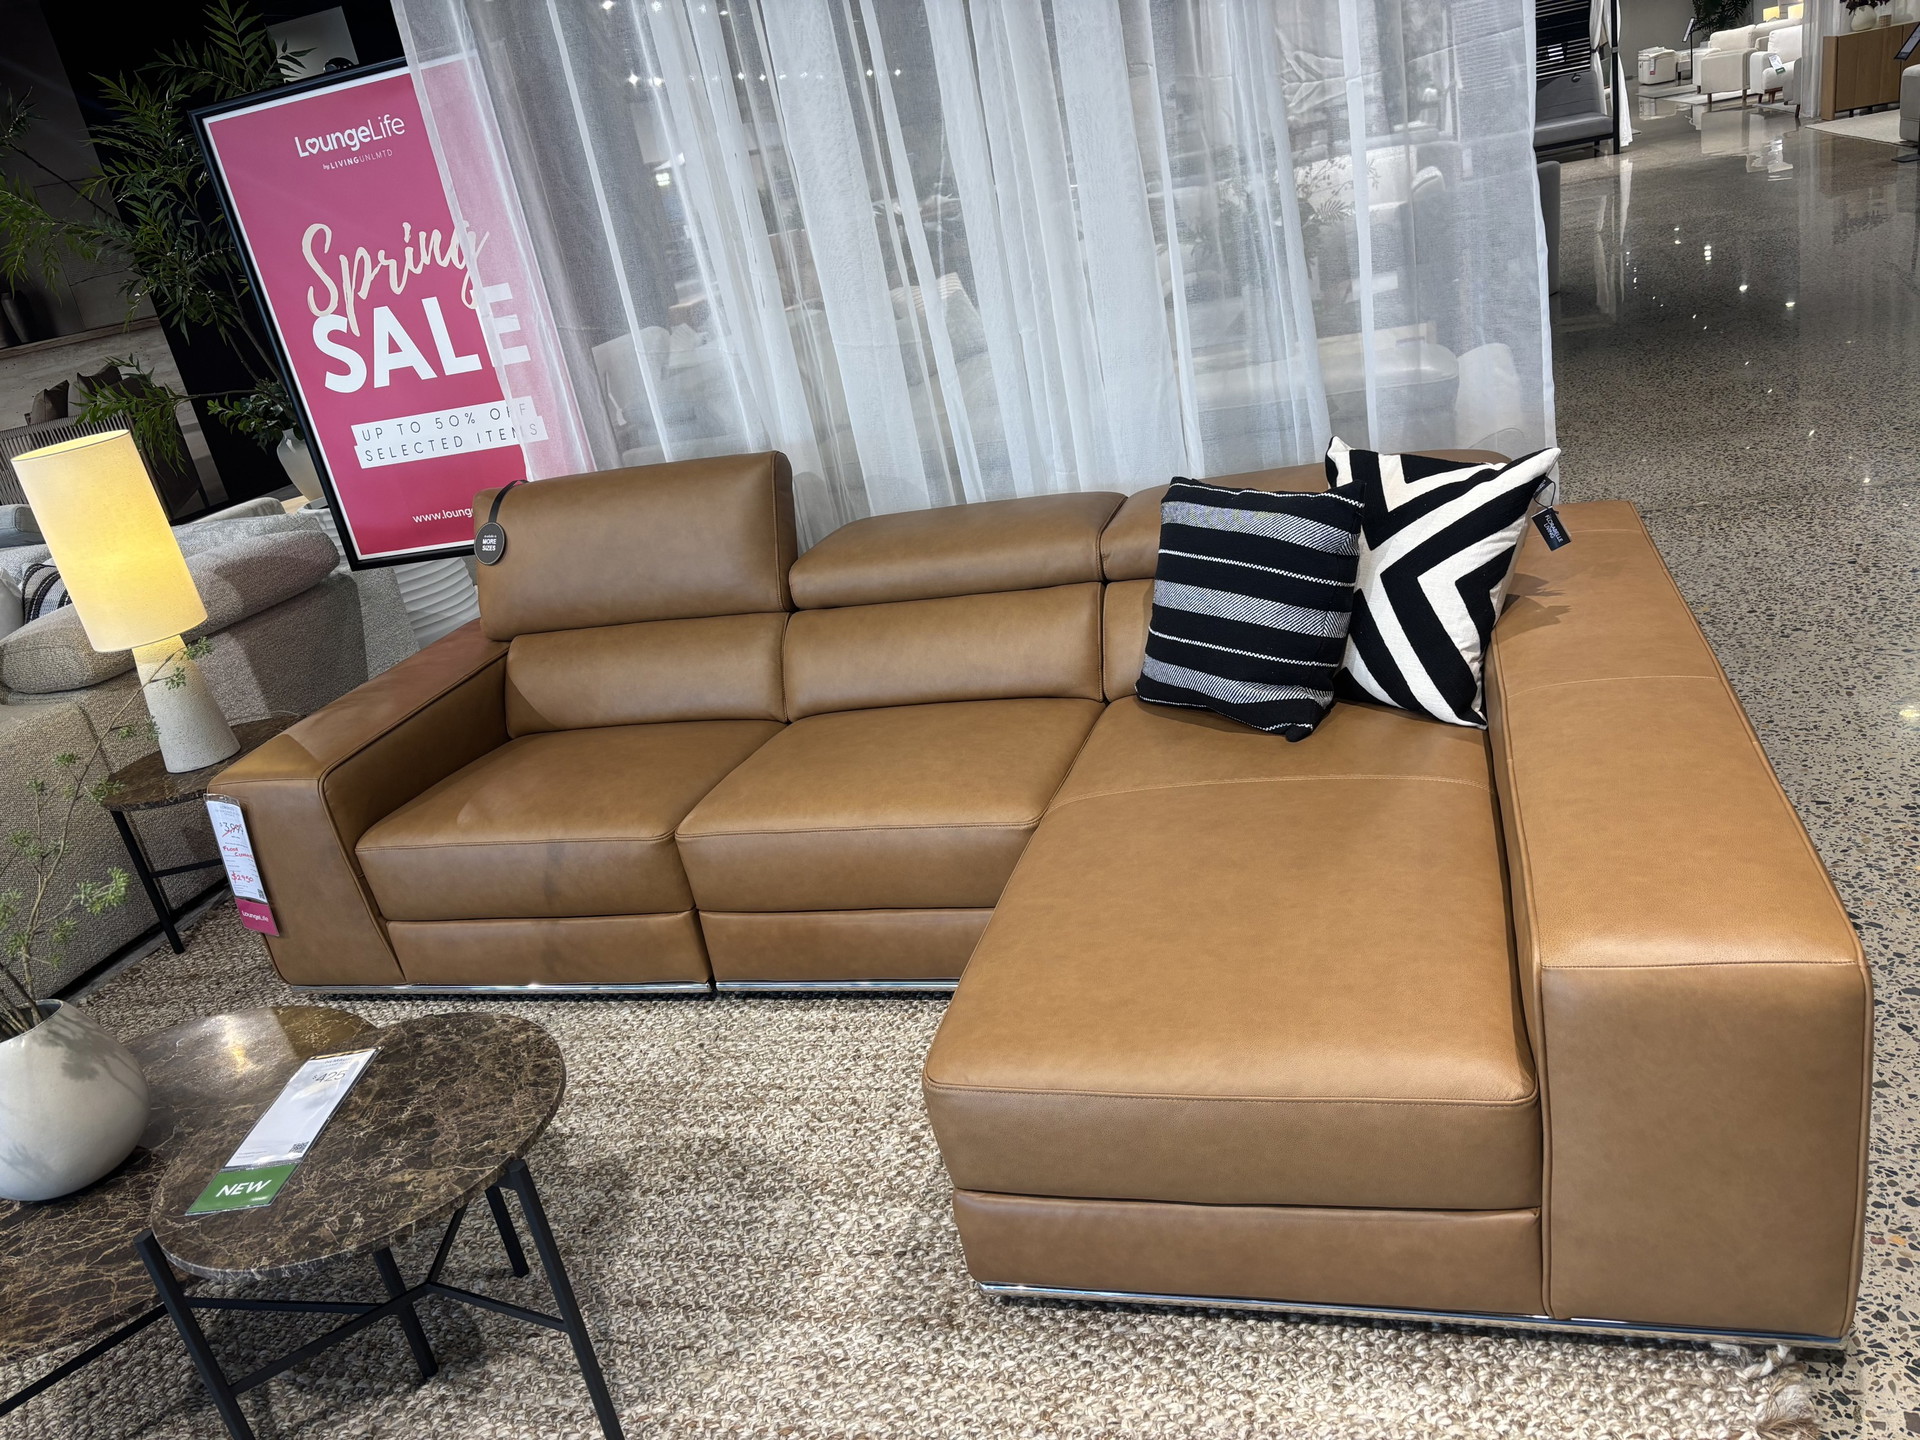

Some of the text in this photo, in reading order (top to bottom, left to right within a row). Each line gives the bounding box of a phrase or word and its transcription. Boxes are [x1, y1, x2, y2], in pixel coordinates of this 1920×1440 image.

[295, 114, 405, 158] LoungeLife
[302, 220, 490, 337] Spring
[312, 282, 531, 394] SALE
[362, 427, 383, 442] UP
[397, 421, 421, 434] TO
[435, 412, 475, 430] 50%
[365, 435, 463, 462] SELECTED
[412, 508, 474, 523] www.loung
[215, 1179, 272, 1198] NEW
